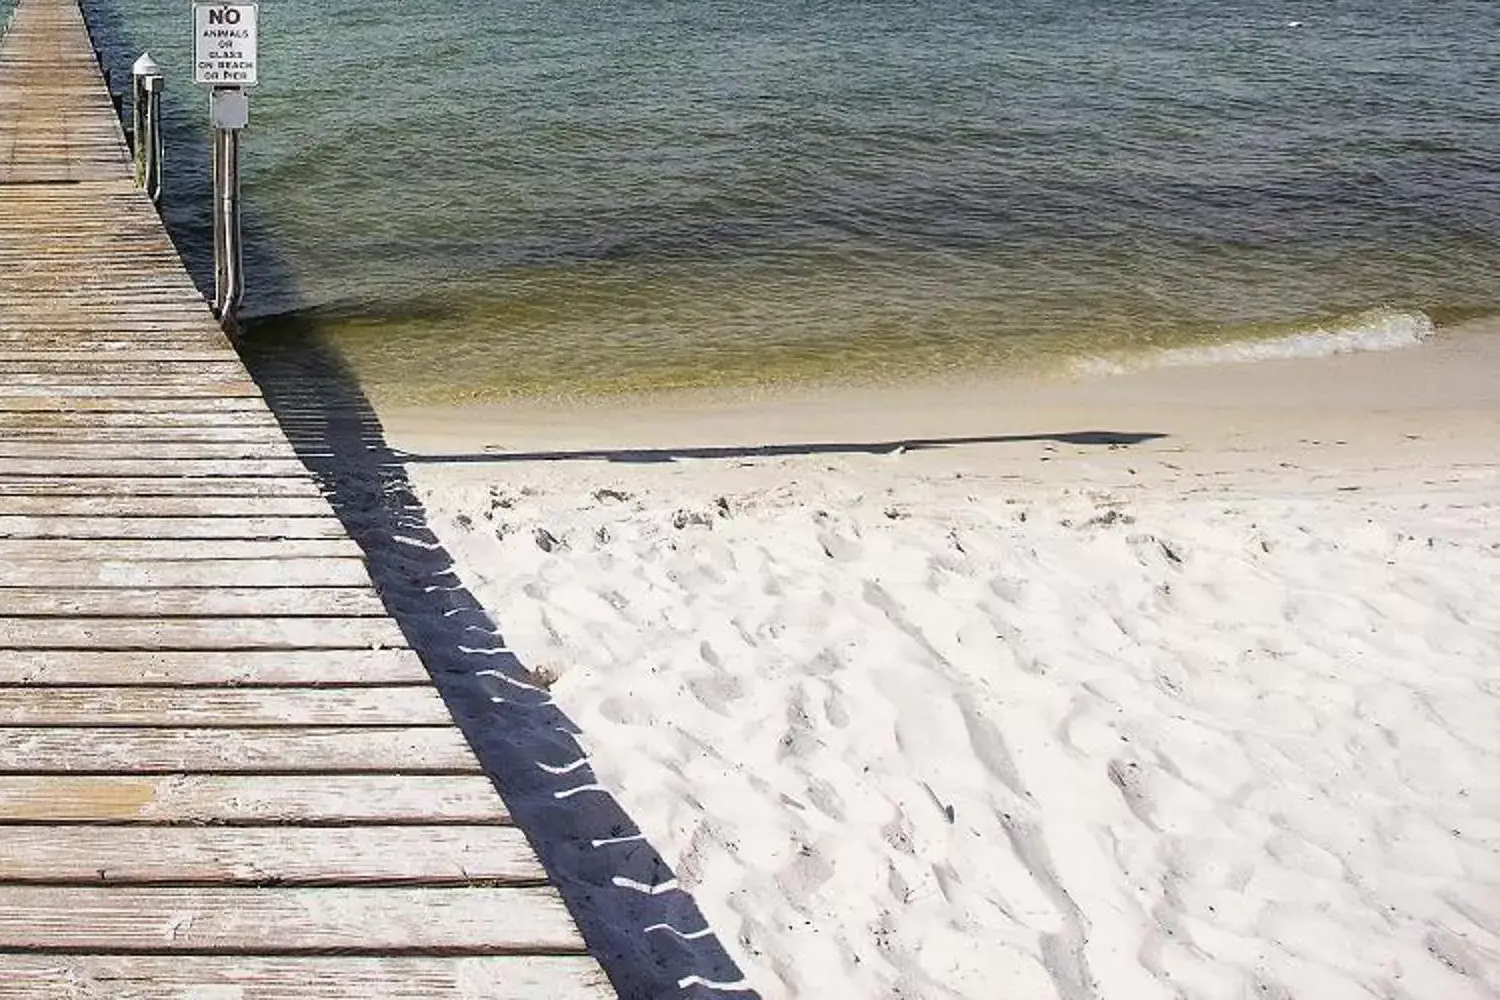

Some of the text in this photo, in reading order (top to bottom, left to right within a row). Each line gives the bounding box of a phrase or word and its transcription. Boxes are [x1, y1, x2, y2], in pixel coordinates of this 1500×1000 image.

[209, 8, 241, 25] NO
[203, 29, 249, 38] ANIMALS
[218, 40, 233, 48] OR
[198, 61, 254, 70] ON BEACH
[203, 71, 247, 80] OR PIER
